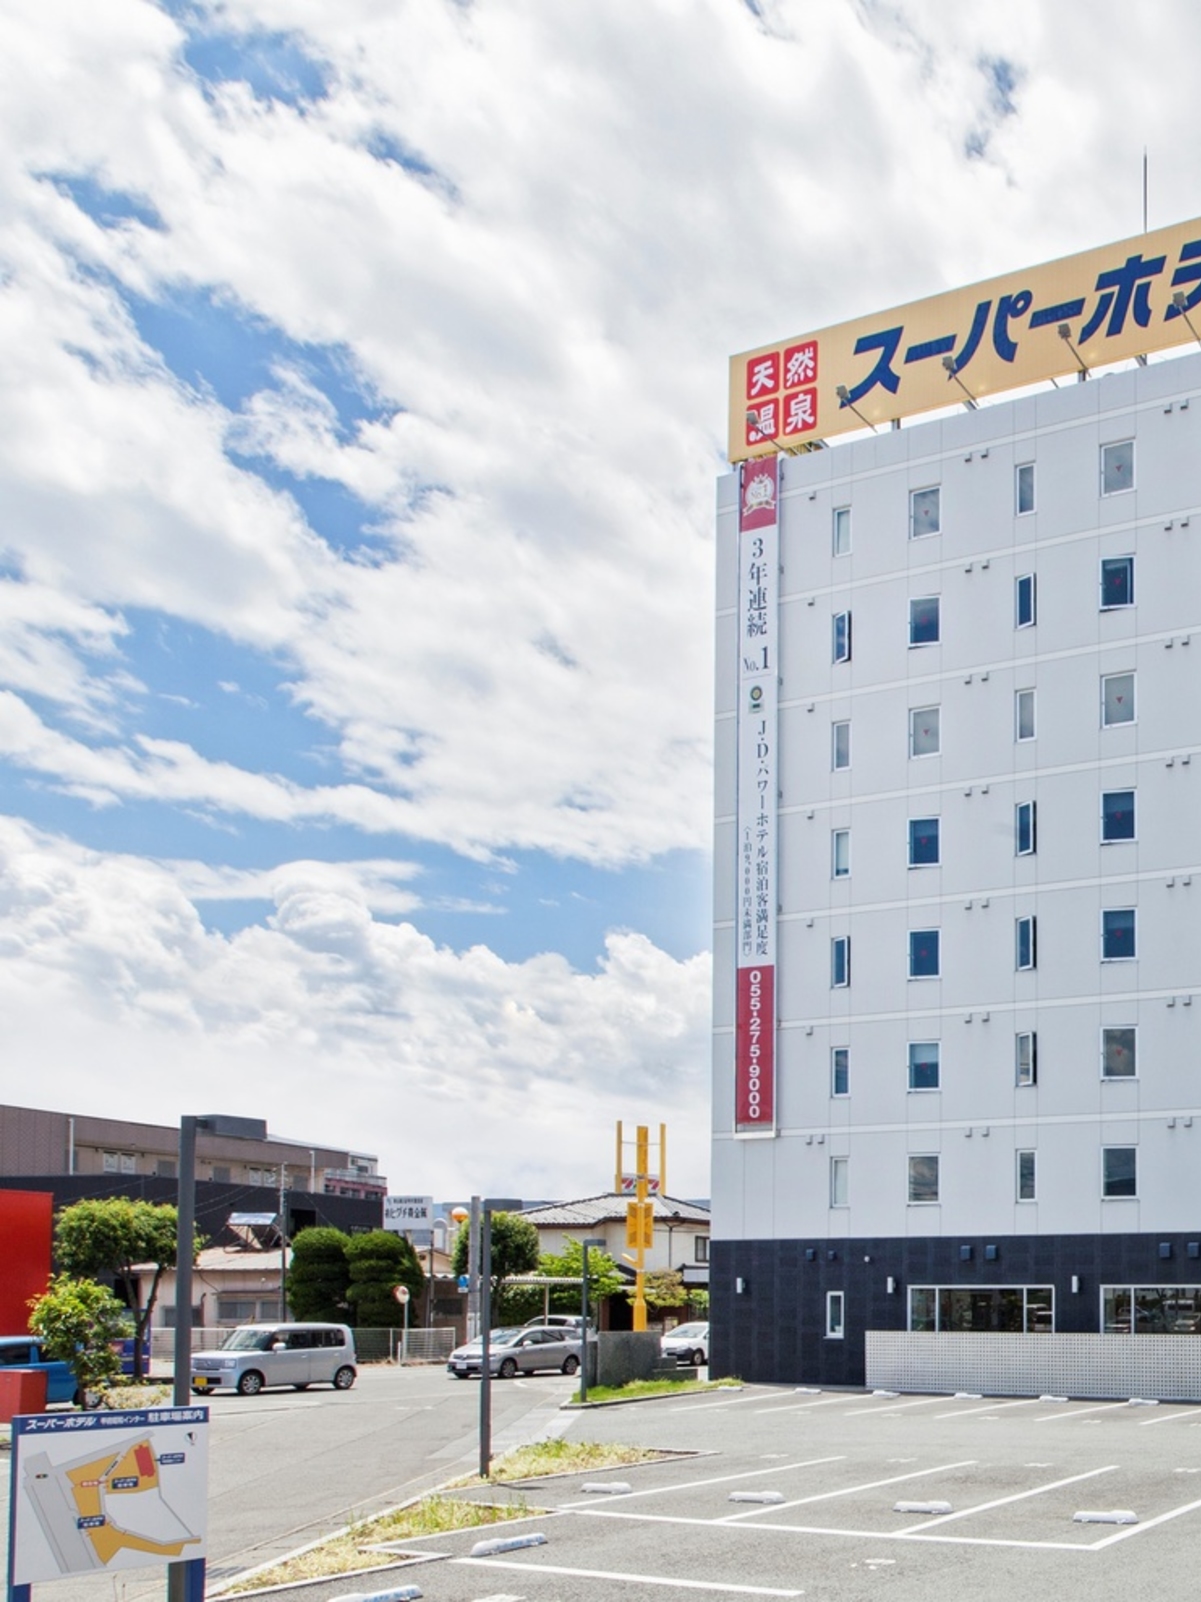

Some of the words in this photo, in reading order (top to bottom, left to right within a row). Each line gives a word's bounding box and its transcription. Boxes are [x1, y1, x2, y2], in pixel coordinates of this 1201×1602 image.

[750, 346, 815, 397] 天然
[746, 537, 768, 638] 3年連続
[25, 1416, 97, 1431] スーパーホテル
